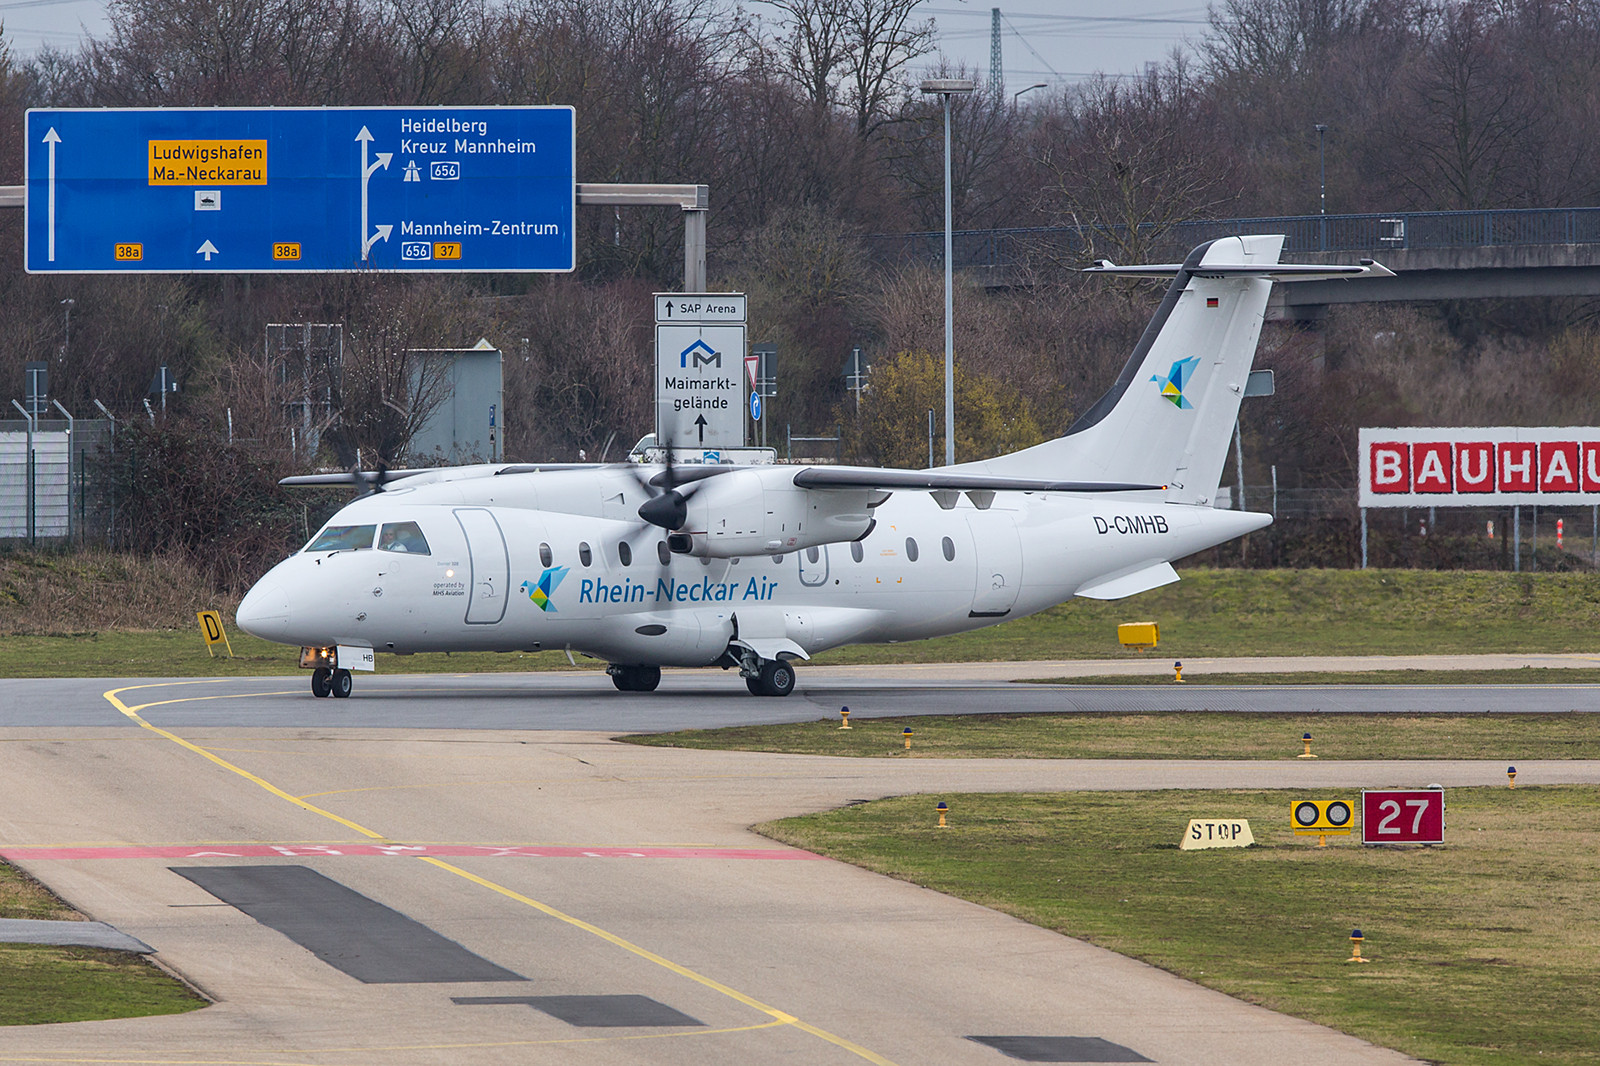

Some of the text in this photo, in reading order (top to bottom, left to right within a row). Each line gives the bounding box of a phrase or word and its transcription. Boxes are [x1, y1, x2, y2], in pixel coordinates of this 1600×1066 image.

[402, 118, 487, 136] Heidelberg
[402, 138, 536, 154] Kreuz Mannheim
[154, 145, 262, 163] Ludwigshafen
[154, 166, 262, 181] Ma.-Neckarau
[434, 166, 456, 176] 656
[402, 220, 559, 236] Mannheim-Zentrum
[118, 246, 140, 258] 38a
[276, 245, 298, 257] 38a
[406, 245, 427, 257] 656
[440, 245, 454, 257] 37
[681, 303, 736, 314] SAP Arena
[665, 376, 737, 390] Maimarkt-
[674, 395, 728, 411] gelände
[1093, 515, 1169, 535] D-CMHB
[433, 582, 465, 590] operated by
[579, 576, 778, 603] Rhein-Neckar Air
[203, 614, 220, 641] D
[363, 654, 374, 663] HB
[1378, 799, 1429, 835] 27
[1191, 823, 1242, 840] STOP
